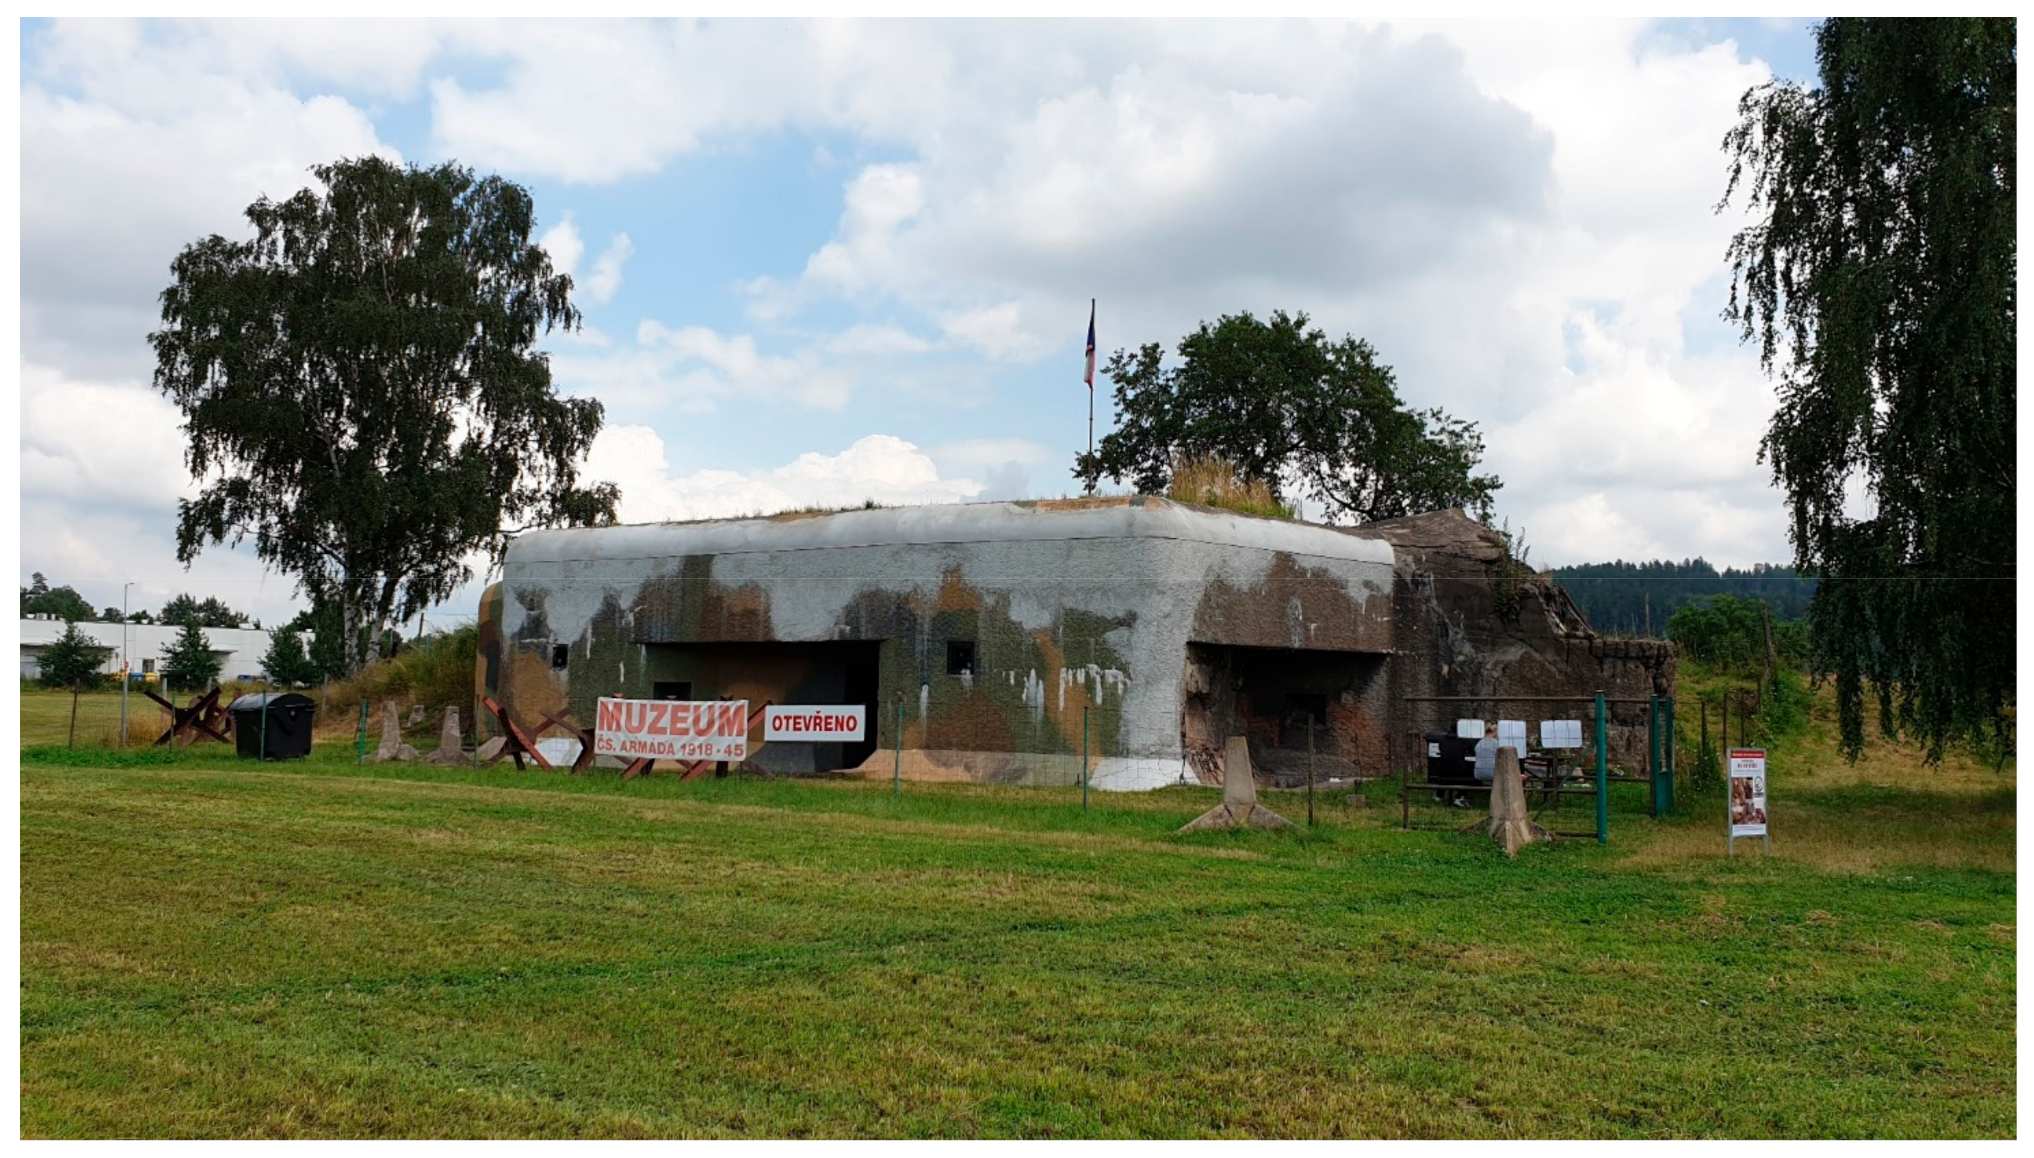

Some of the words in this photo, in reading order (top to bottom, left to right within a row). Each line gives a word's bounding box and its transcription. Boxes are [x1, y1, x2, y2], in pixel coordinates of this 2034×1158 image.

[598, 700, 745, 737] MUZEUM
[772, 710, 858, 732] OTEVŘENO
[620, 738, 675, 756] ARMÁDA
[680, 742, 713, 757] 1918
[724, 743, 744, 757] 45
